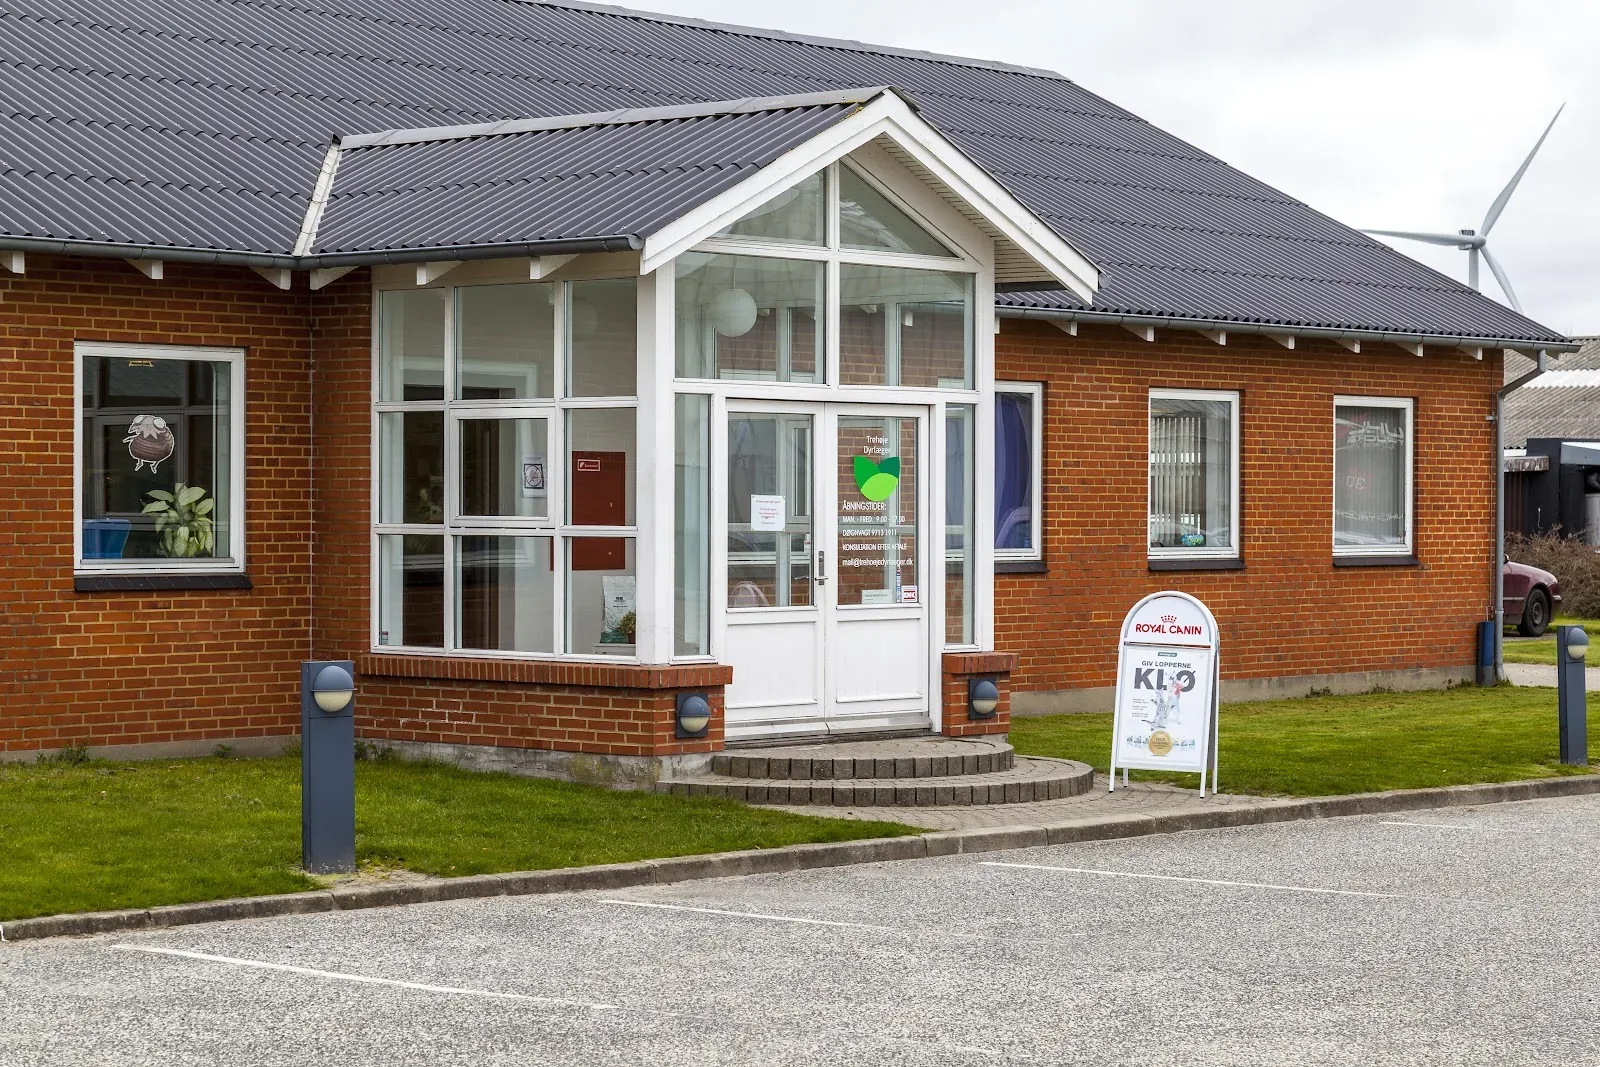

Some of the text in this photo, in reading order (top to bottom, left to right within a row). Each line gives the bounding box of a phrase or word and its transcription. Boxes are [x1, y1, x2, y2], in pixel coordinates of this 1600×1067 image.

[866, 435, 889, 445] Trehøje
[863, 445, 891, 455] Dyrlæger
[842, 499, 887, 511] ÅBNINGSTIDER:
[876, 515, 888, 523] 9.00
[892, 515, 906, 523] 17.00
[842, 528, 897, 537] DØGNVAGT 9713 1911
[842, 543, 908, 551] KONSULTATION EFTER AFTALE
[1135, 623, 1202, 635] ROYAL CANIN
[1155, 661, 1192, 669] LOPPERNE
[1133, 667, 1196, 693] KLØ
